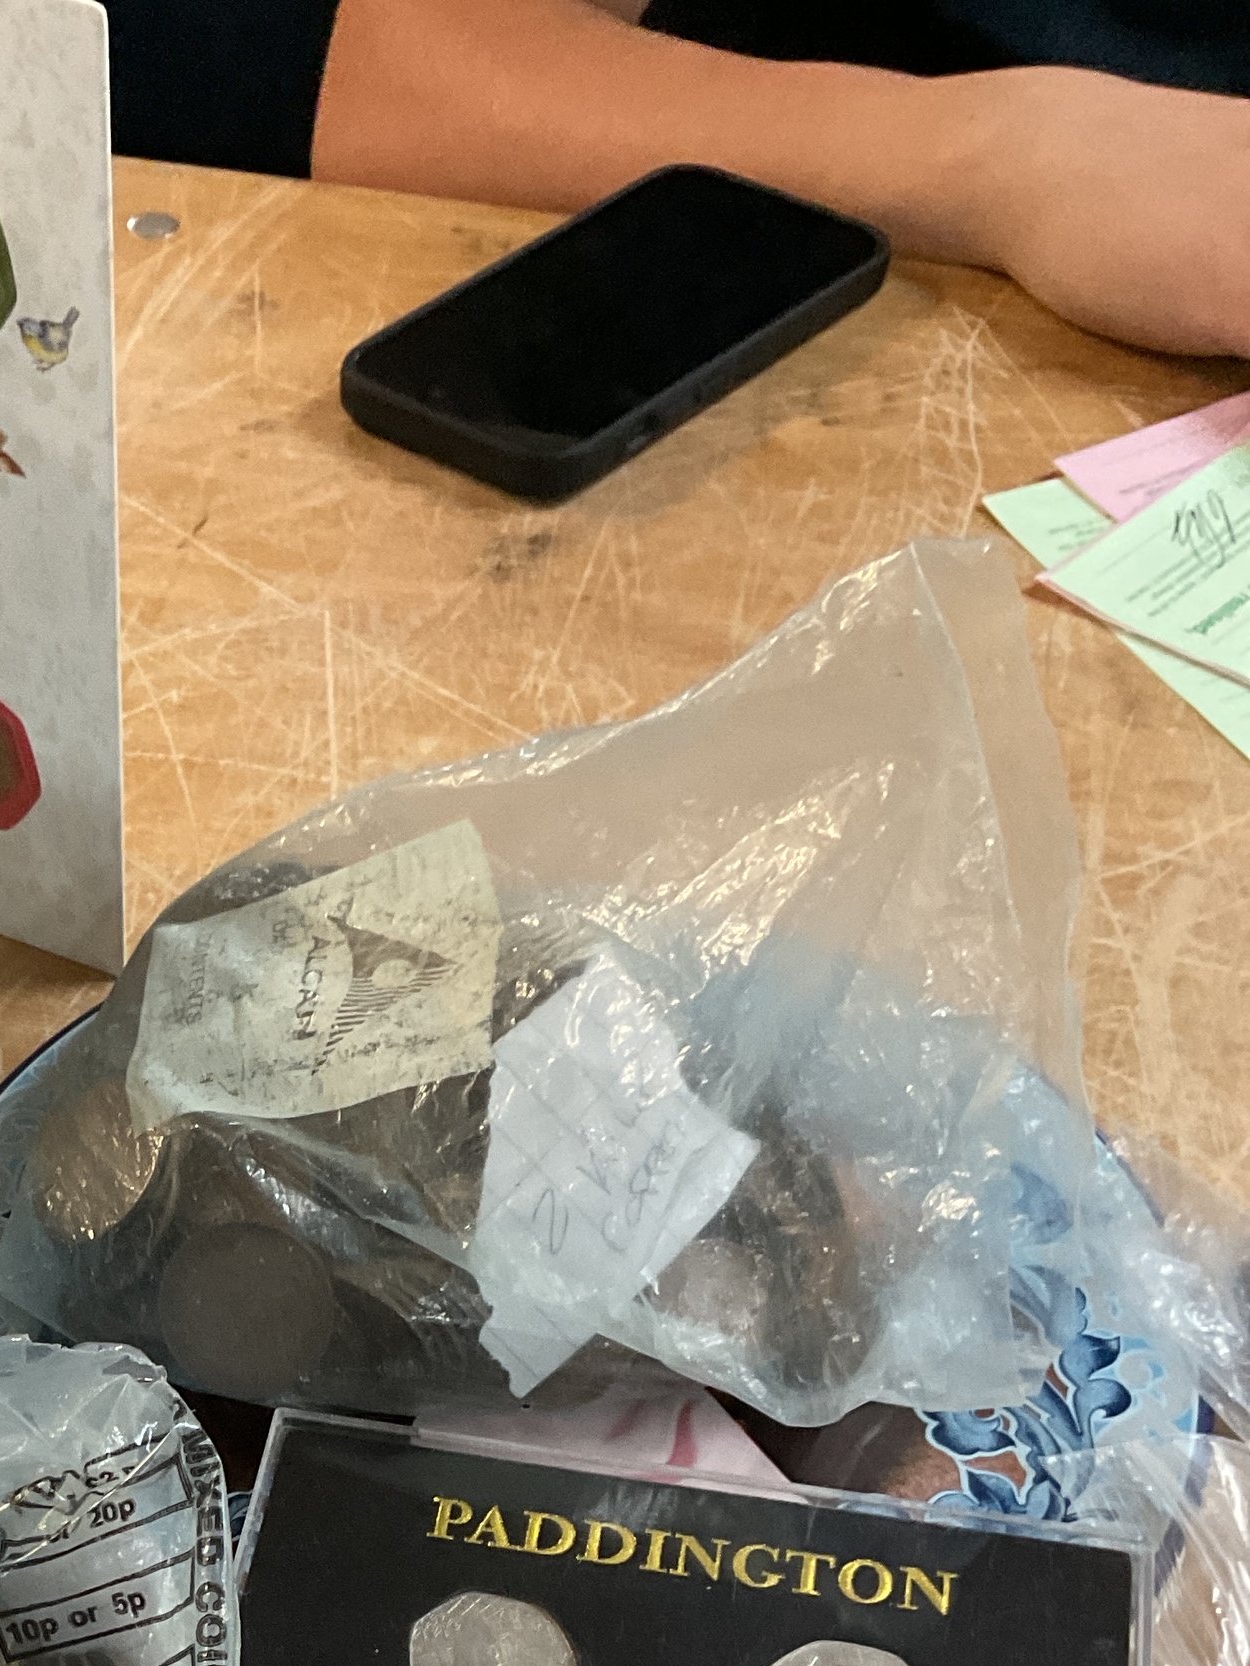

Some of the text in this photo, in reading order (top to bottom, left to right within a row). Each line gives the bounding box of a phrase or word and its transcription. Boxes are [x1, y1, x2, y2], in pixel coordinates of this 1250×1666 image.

[292, 935, 330, 1042] ALCAN
[88, 1499, 136, 1529] 20p
[182, 1428, 224, 1566] MIXED
[427, 1495, 958, 1615] PADDINGTON
[6, 1616, 59, 1645] 10p
[68, 1606, 98, 1628] or
[111, 1591, 147, 1619] 5p
